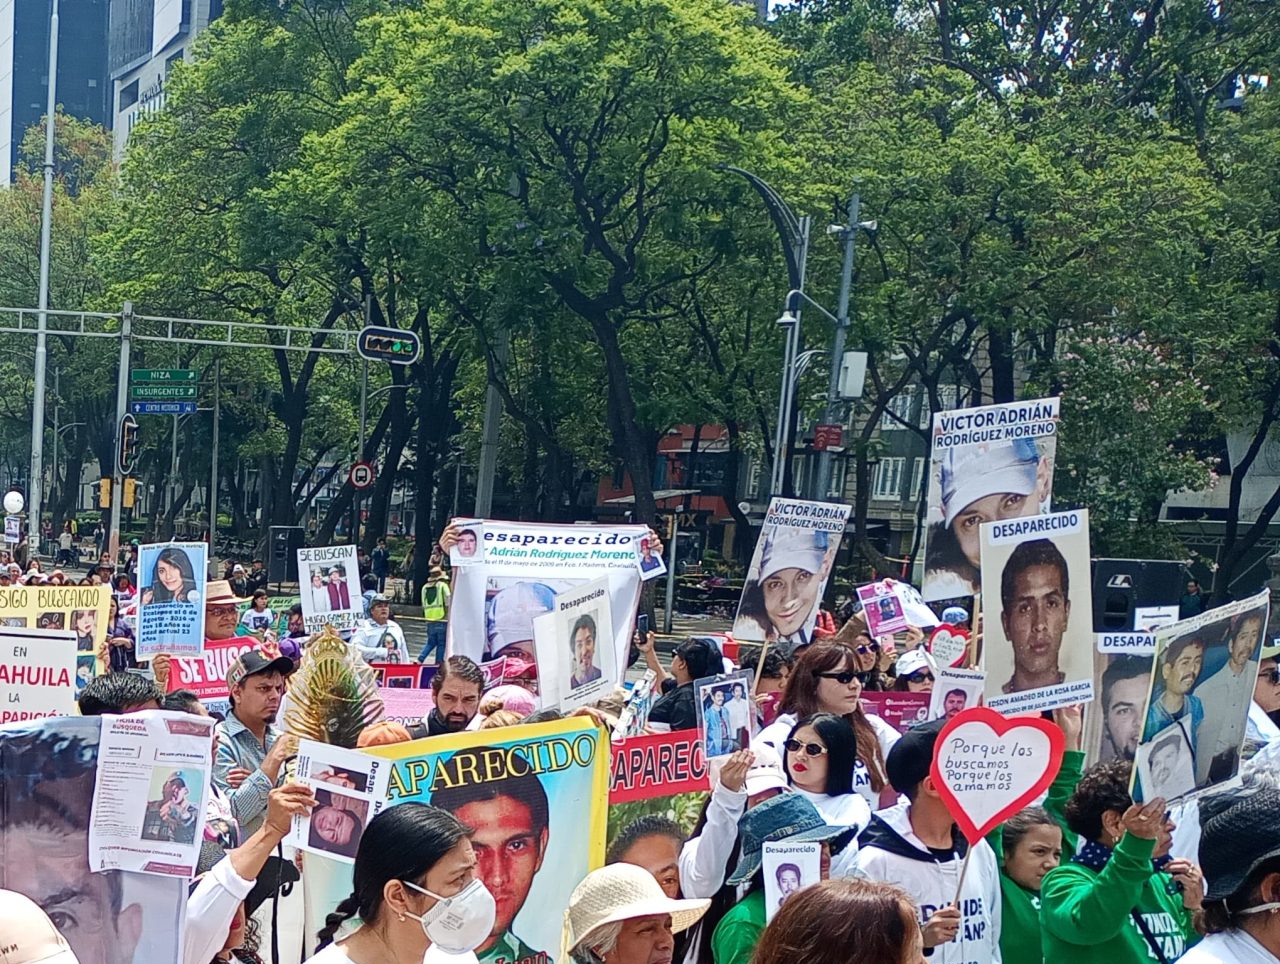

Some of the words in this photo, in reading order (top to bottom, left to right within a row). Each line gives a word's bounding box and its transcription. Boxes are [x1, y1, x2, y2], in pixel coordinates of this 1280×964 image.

[150, 371, 171, 379] NIZA
[136, 388, 184, 396] INSURGENTES
[941, 412, 995, 431] VICTOR
[998, 403, 1053, 425] ADRIÁN
[936, 429, 1002, 448] RODRÍGUEZ
[1005, 422, 1055, 439] MORENO
[774, 503, 810, 517] VICTOR
[810, 506, 847, 520] ADRIÁN
[768, 516, 811, 529] RODRÍGUEZ
[810, 520, 844, 532] MORENO
[993, 513, 1078, 539] DESAPARECIDO
[483, 530, 631, 546] esaparecido
[314, 547, 353, 560] BUSCAN
[489, 546, 527, 557] Adrián
[37, 588, 100, 608] BUSCANDO
[560, 589, 605, 611] Desaparecido
[13, 646, 28, 657] EN
[179, 654, 203, 685] SE
[8, 692, 20, 703] LA
[988, 698, 1009, 708] EDSON
[950, 738, 1006, 755] Porque
[1011, 742, 1033, 756] los
[386, 733, 596, 800] APARECIDO
[945, 756, 1009, 770] buscamos
[946, 770, 992, 783] Porque
[994, 770, 1012, 782] los
[953, 782, 1012, 792] amamos
[765, 845, 816, 854] Desaparecido
